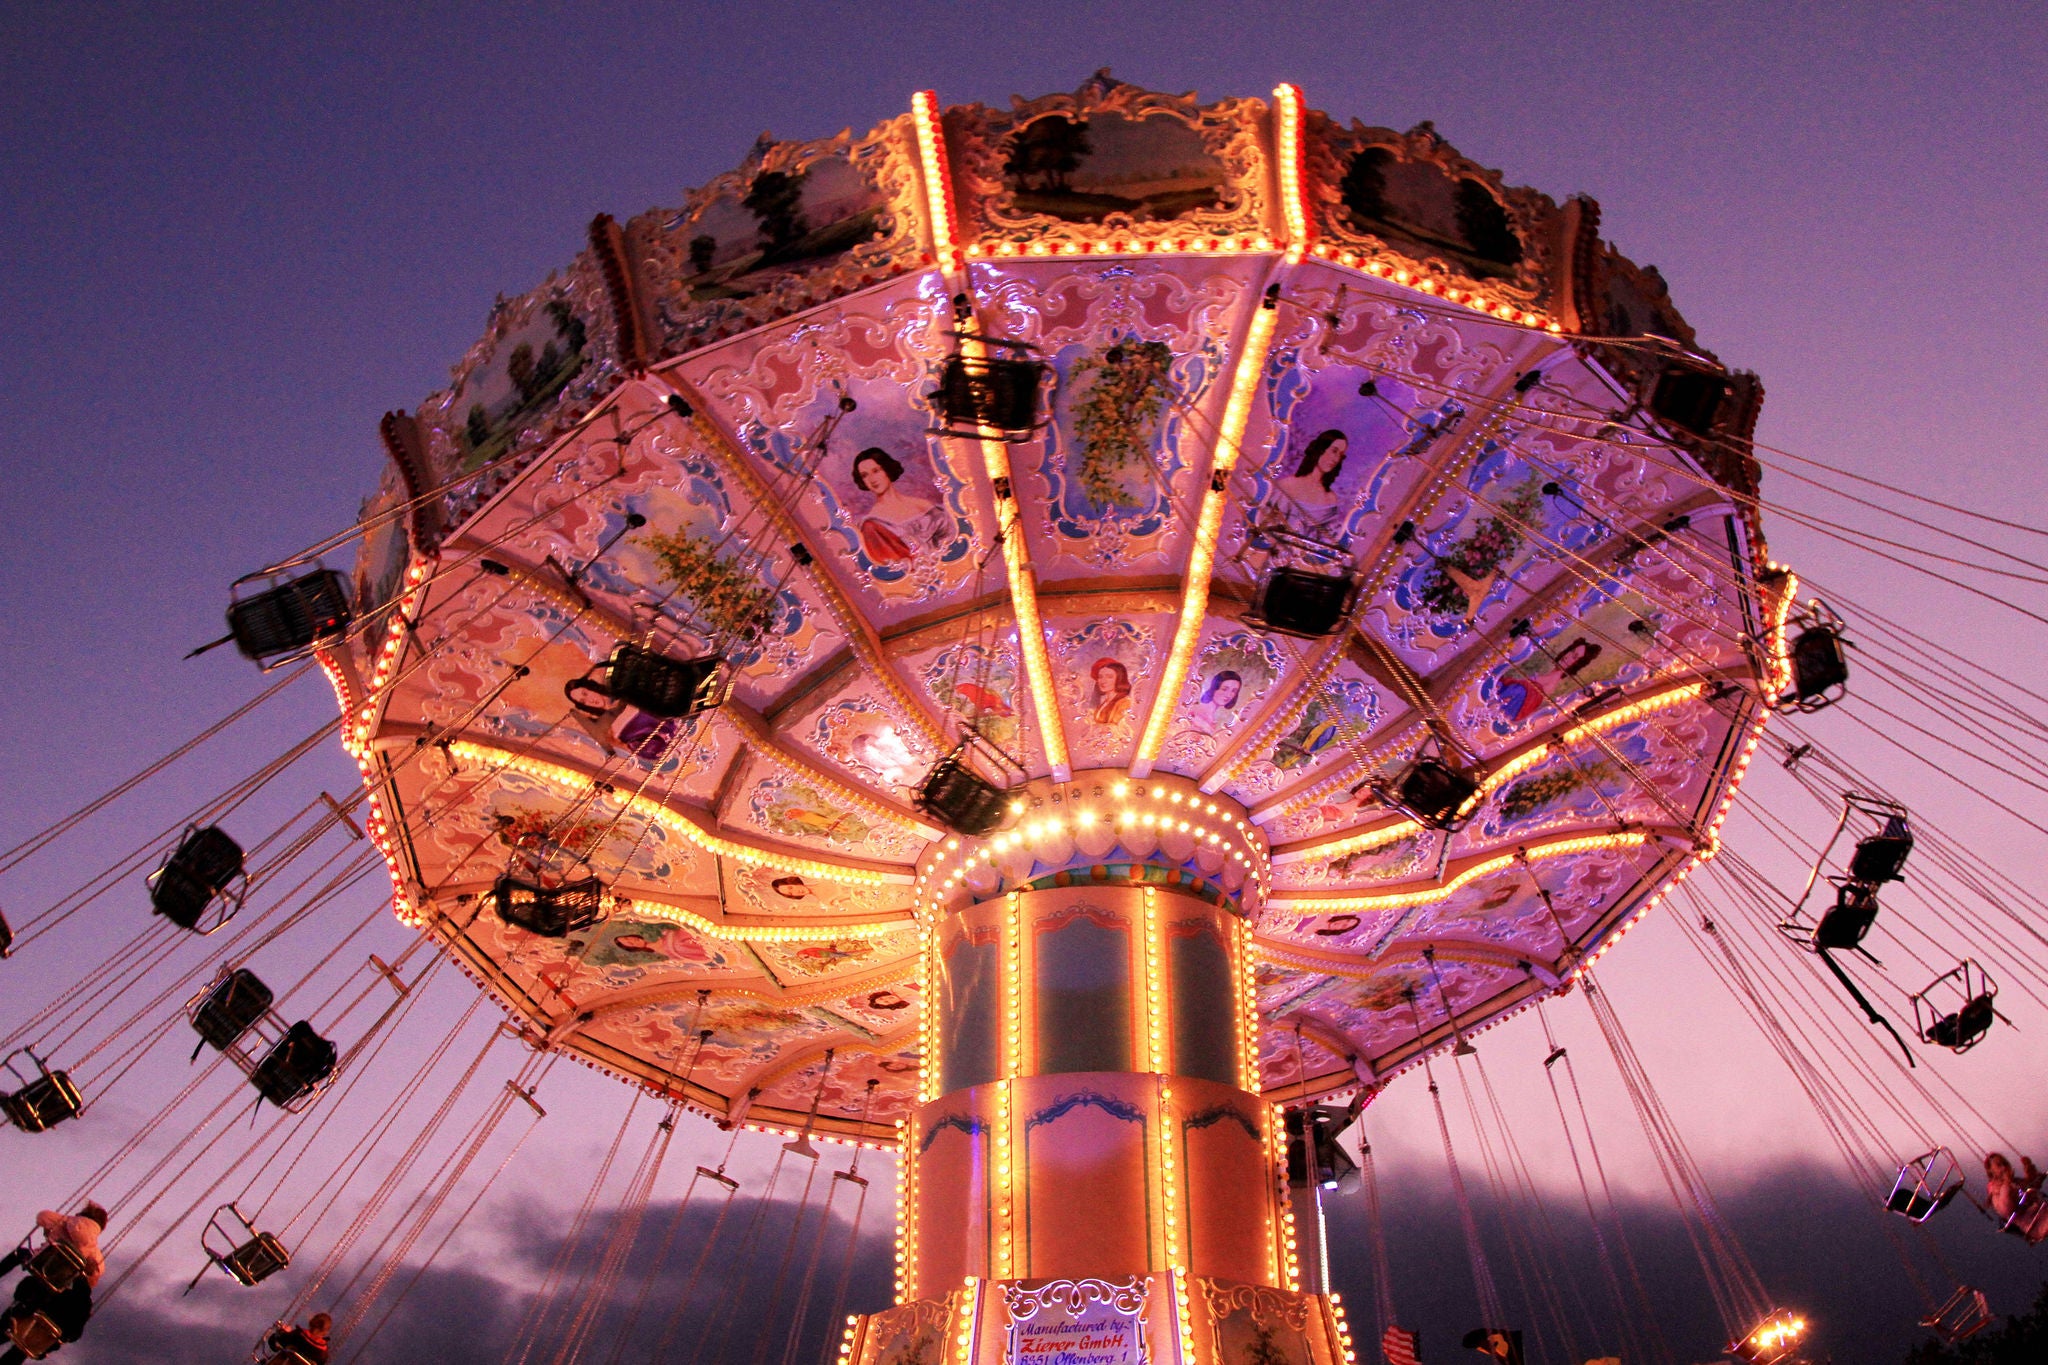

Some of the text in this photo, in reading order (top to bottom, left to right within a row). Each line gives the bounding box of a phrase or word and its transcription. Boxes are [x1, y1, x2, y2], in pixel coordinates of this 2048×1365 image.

[1021, 1320, 1106, 1335] Manufactured
[1020, 1338, 1075, 1353] Zierer
[1054, 1352, 1115, 1365] Offenberg
[1122, 1351, 1128, 1362] 1
